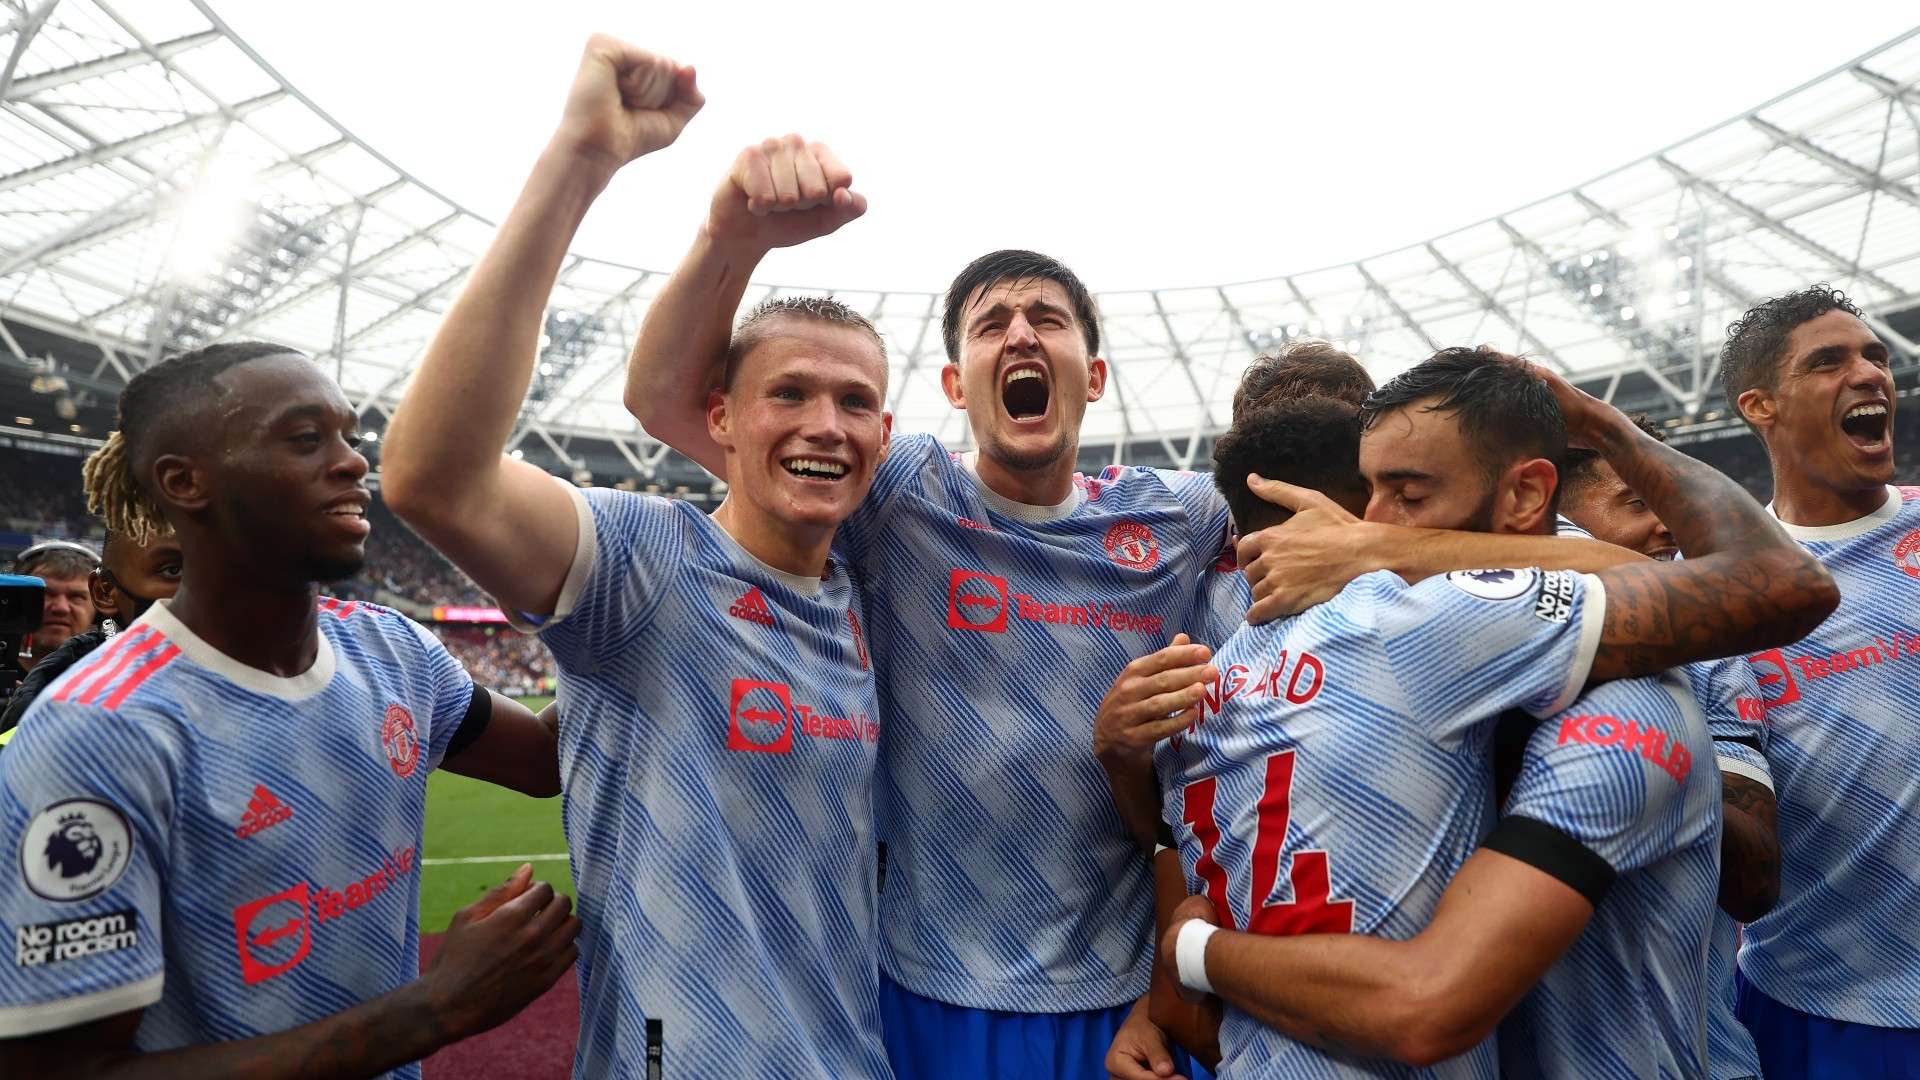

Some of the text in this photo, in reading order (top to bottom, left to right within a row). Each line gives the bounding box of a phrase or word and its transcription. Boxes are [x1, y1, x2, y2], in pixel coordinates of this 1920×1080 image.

[1106, 523, 1149, 548] MANCHESTER
[1011, 592, 1164, 636] TeamViewer
[1535, 593, 1557, 622] No
[1549, 599, 1571, 624] for
[1170, 649, 1326, 752] NGARD
[795, 704, 881, 744] TeamVie
[234, 805, 294, 840] adidas
[1182, 749, 1356, 936] 14
[312, 844, 416, 926] TeamVie
[17, 913, 127, 948] No room
[17, 930, 137, 968] for racism
